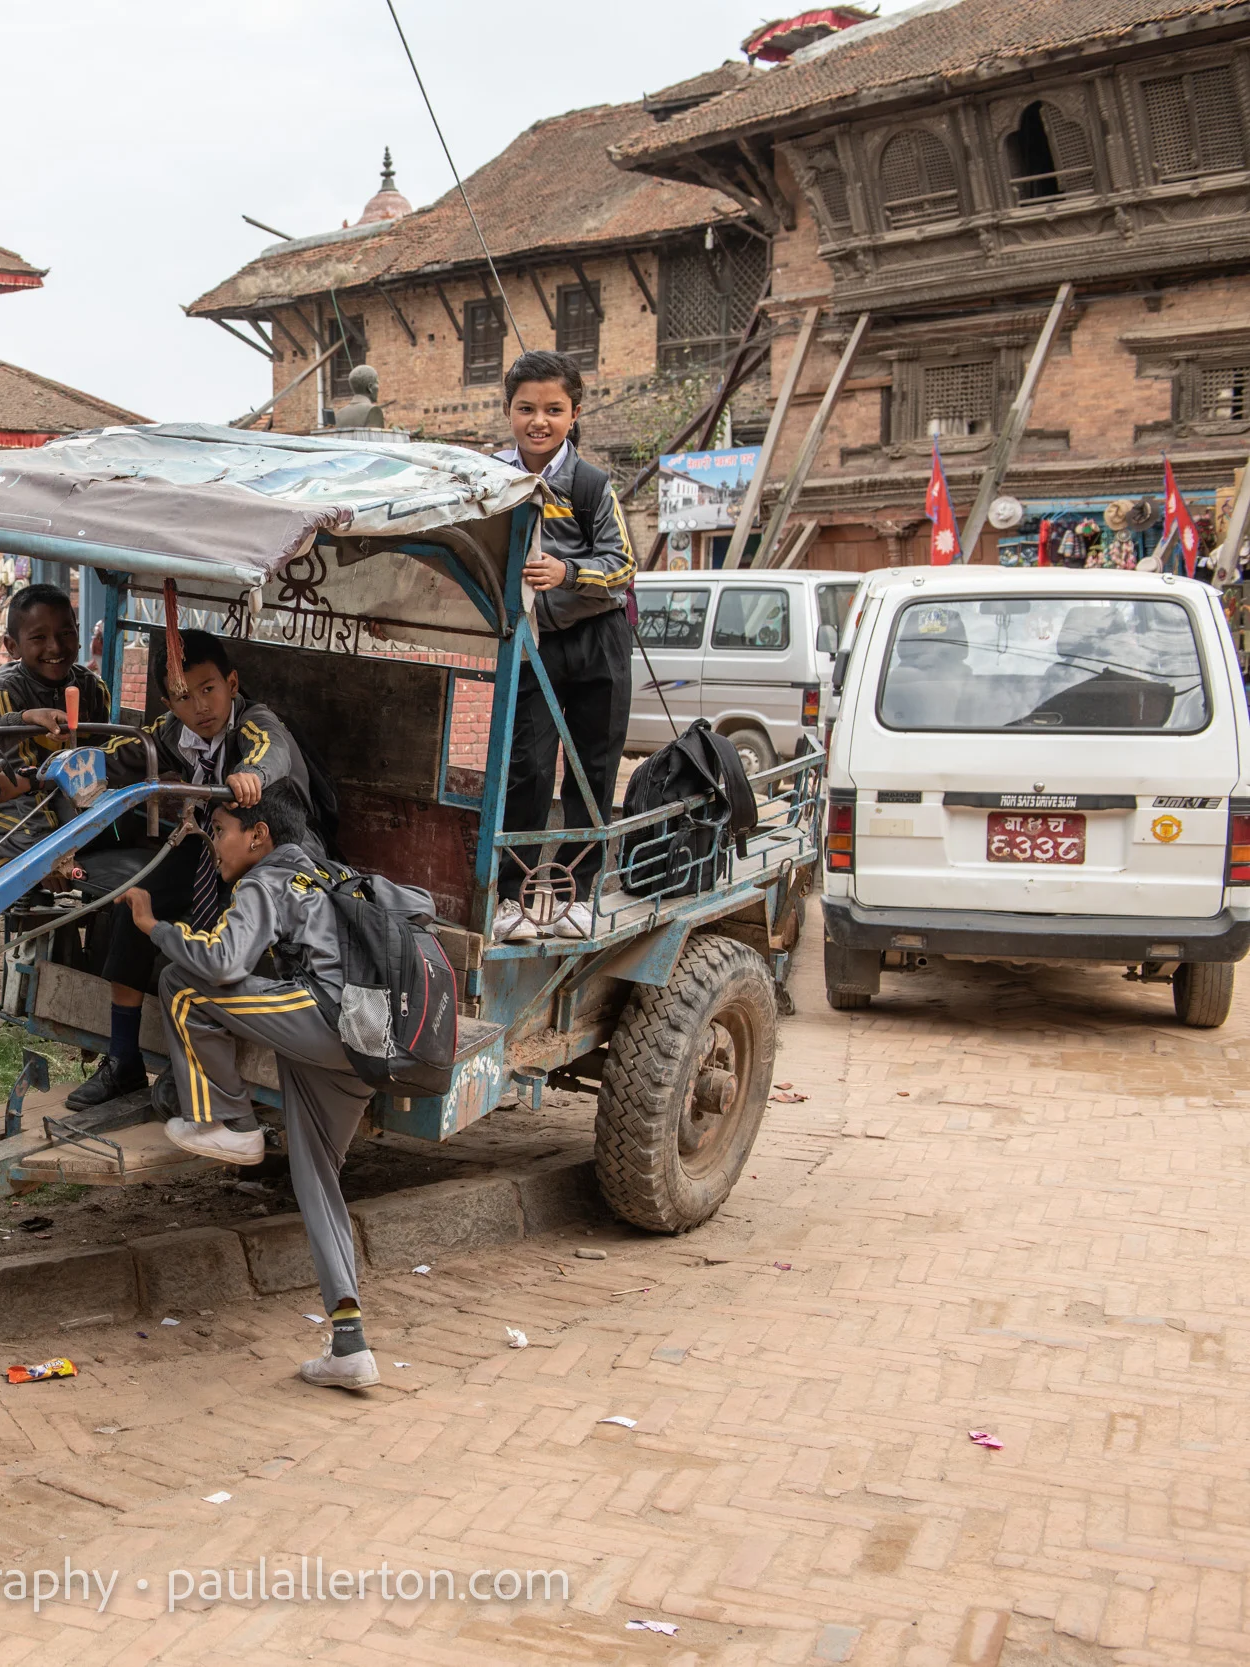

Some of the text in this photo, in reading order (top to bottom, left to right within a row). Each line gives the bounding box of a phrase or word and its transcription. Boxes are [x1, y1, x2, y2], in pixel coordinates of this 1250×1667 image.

[1036, 796, 1057, 807] DRIVE
[1058, 796, 1078, 808] SLOW
[431, 992, 450, 1036] POWER
